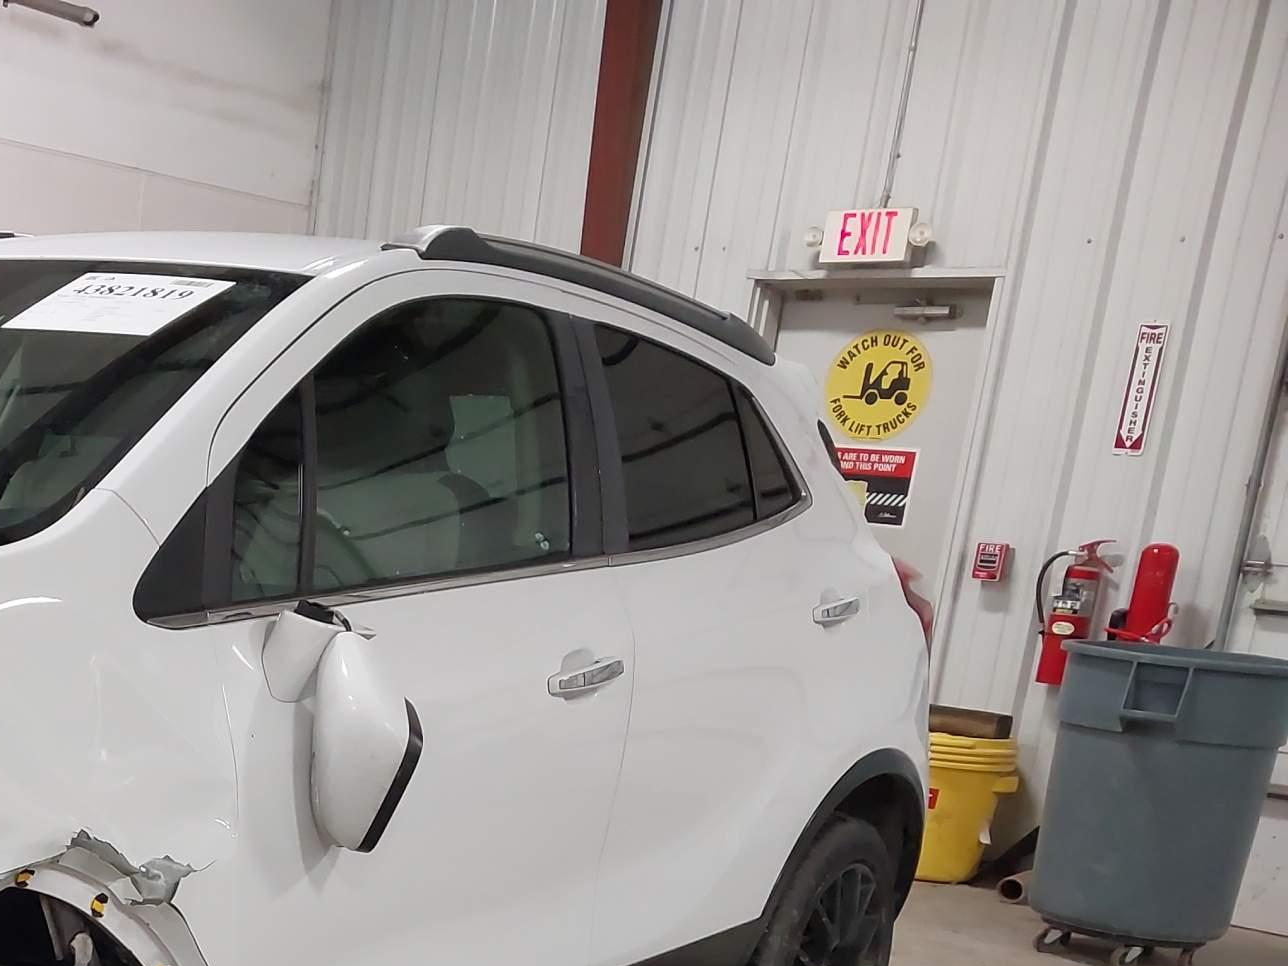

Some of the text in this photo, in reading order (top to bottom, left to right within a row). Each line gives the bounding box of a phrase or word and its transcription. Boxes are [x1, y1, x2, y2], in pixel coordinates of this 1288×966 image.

[837, 211, 899, 255] EXIT
[73, 284, 195, 299] 43821819
[1140, 332, 1163, 344] FIRE
[837, 334, 926, 372] WATCH OUT FOR
[1125, 346, 1153, 442] EXTINGUISHER
[830, 398, 917, 436] FORK LIFT TRUCKS
[842, 452, 858, 460] ARE
[859, 453, 869, 461] TO
[870, 454, 881, 462] BE
[881, 455, 906, 464] WORN
[856, 462, 872, 470] THIS
[873, 463, 897, 472] POINT
[979, 543, 1001, 553] FIRE
